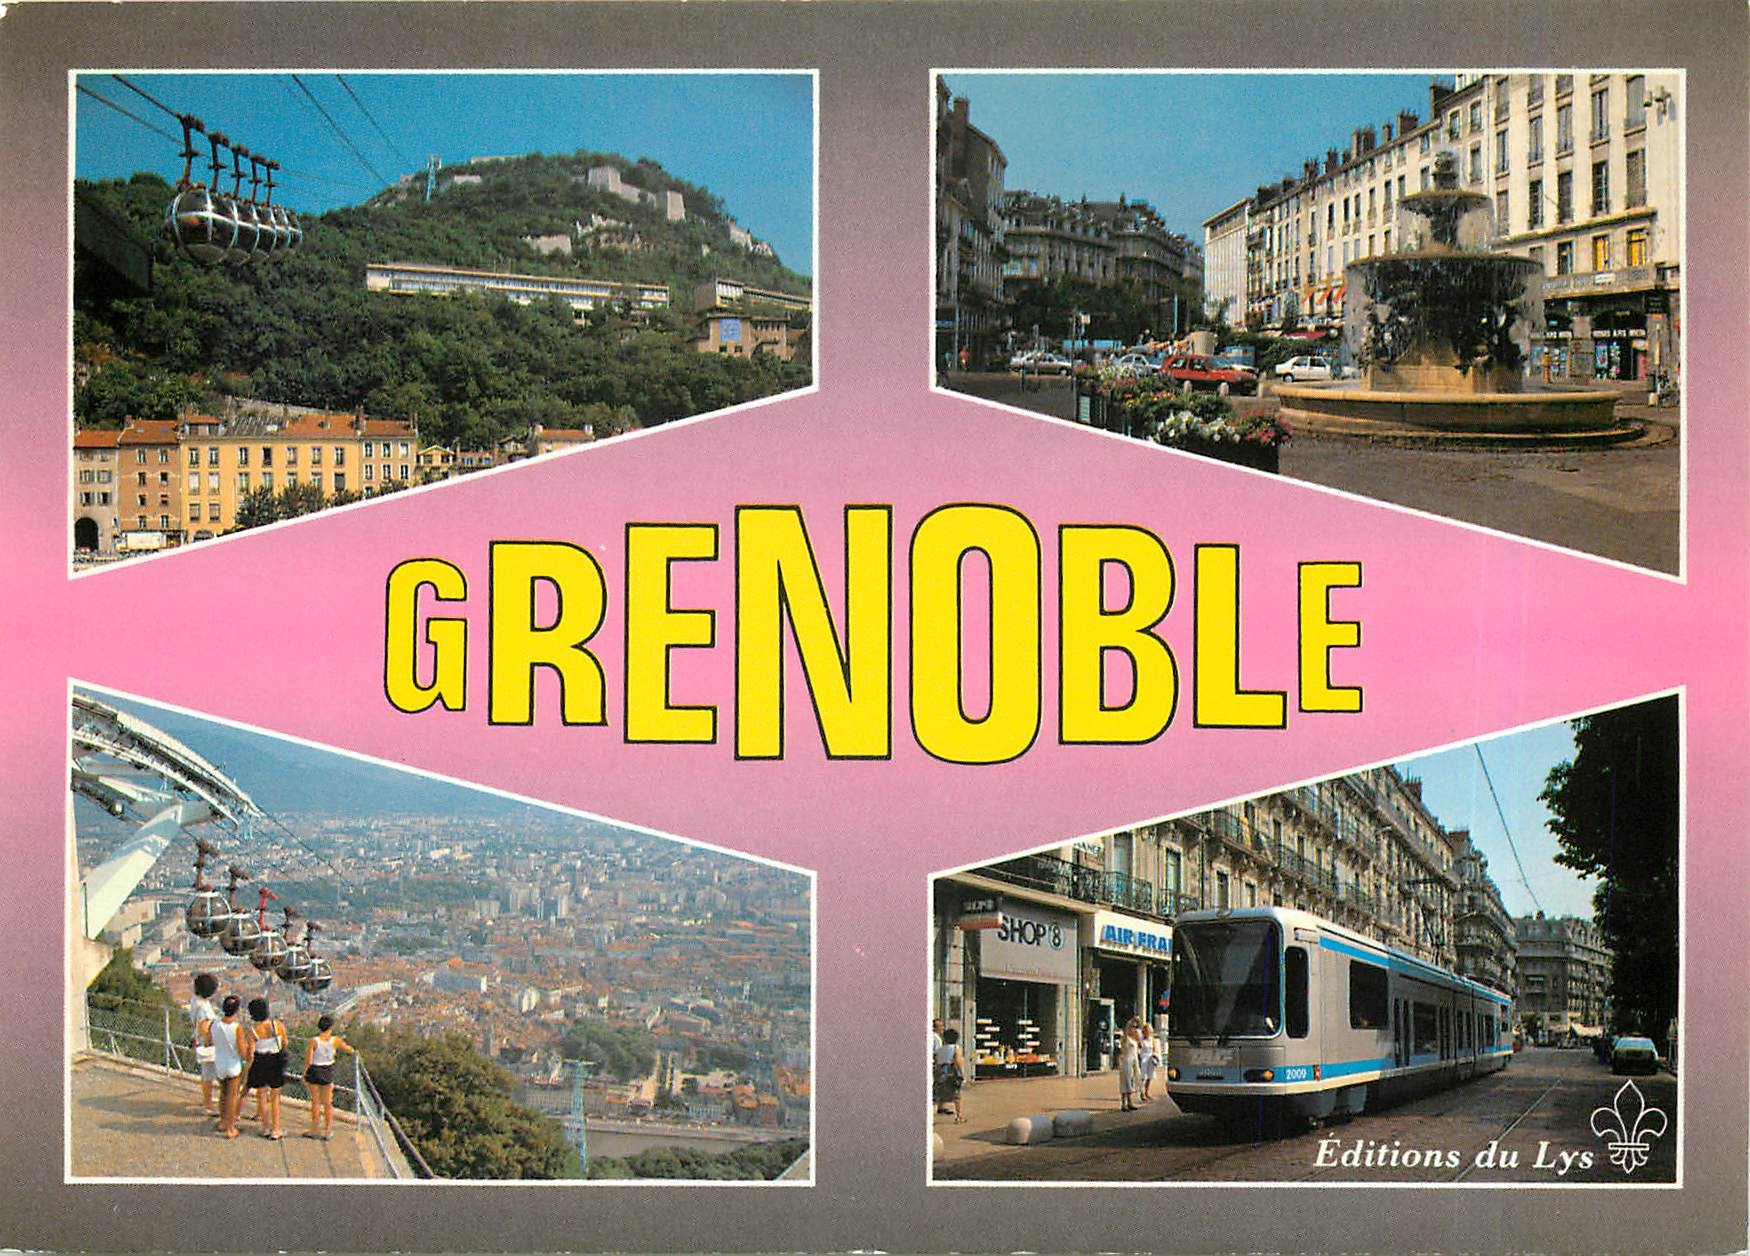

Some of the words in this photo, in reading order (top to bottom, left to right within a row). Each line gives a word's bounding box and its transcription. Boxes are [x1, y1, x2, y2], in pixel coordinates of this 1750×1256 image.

[997, 915, 1047, 946] SHOP
[1103, 924, 1133, 944] AIR
[1286, 1068, 1308, 1080] 2009
